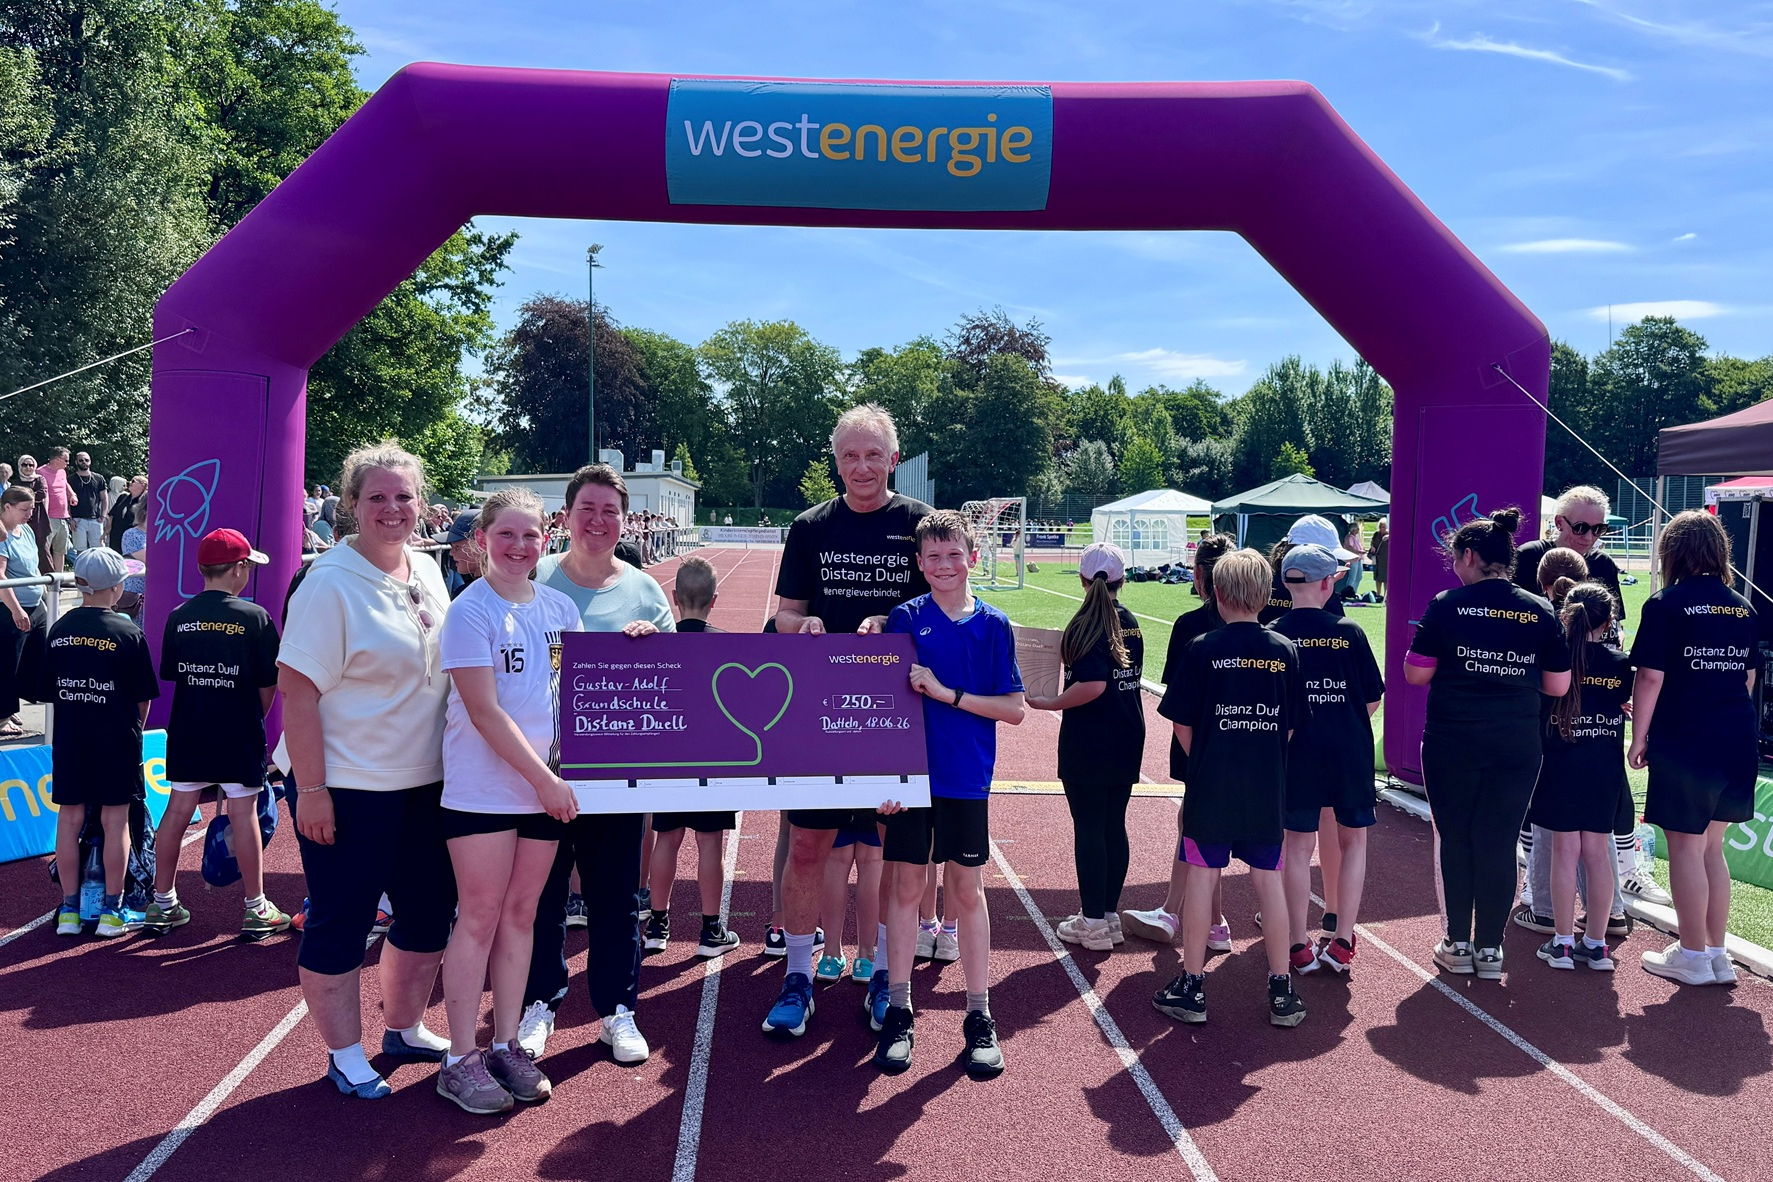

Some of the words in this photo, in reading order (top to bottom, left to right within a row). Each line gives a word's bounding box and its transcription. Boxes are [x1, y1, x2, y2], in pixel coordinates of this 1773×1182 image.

[683, 113, 1034, 178] westenergie
[819, 551, 909, 568] Westenergie
[820, 567, 872, 581] Distanz
[876, 568, 911, 584] Duell
[823, 587, 901, 598] #energieverbindet
[1457, 606, 1539, 624] westenergie
[177, 620, 245, 635] westenergie
[51, 634, 117, 651] westenergie
[1292, 637, 1350, 649] stenergie
[1457, 646, 1504, 661] Distanz
[1506, 651, 1536, 664] Duell
[1684, 646, 1726, 657] Distanz
[500, 648, 525, 674] 15
[828, 652, 900, 666] westenergie
[1212, 656, 1286, 673] westenergie
[1691, 659, 1745, 672] Champion
[178, 662, 216, 674] Distanz
[1465, 660, 1526, 676] Champion
[57, 677, 87, 688] istanz
[88, 678, 115, 691] Duell
[187, 675, 235, 688] Champion
[1323, 678, 1347, 689] Due
[573, 693, 669, 711] Grundschule
[822, 699, 829, 707] €
[1308, 692, 1346, 704] mpion
[1215, 703, 1252, 716] Distanz
[575, 714, 636, 732] Distanz
[640, 714, 688, 731] Duell
[865, 716, 910, 729] 18.06.26
[1219, 719, 1278, 732] Champion
[1596, 713, 1623, 726] Duell
